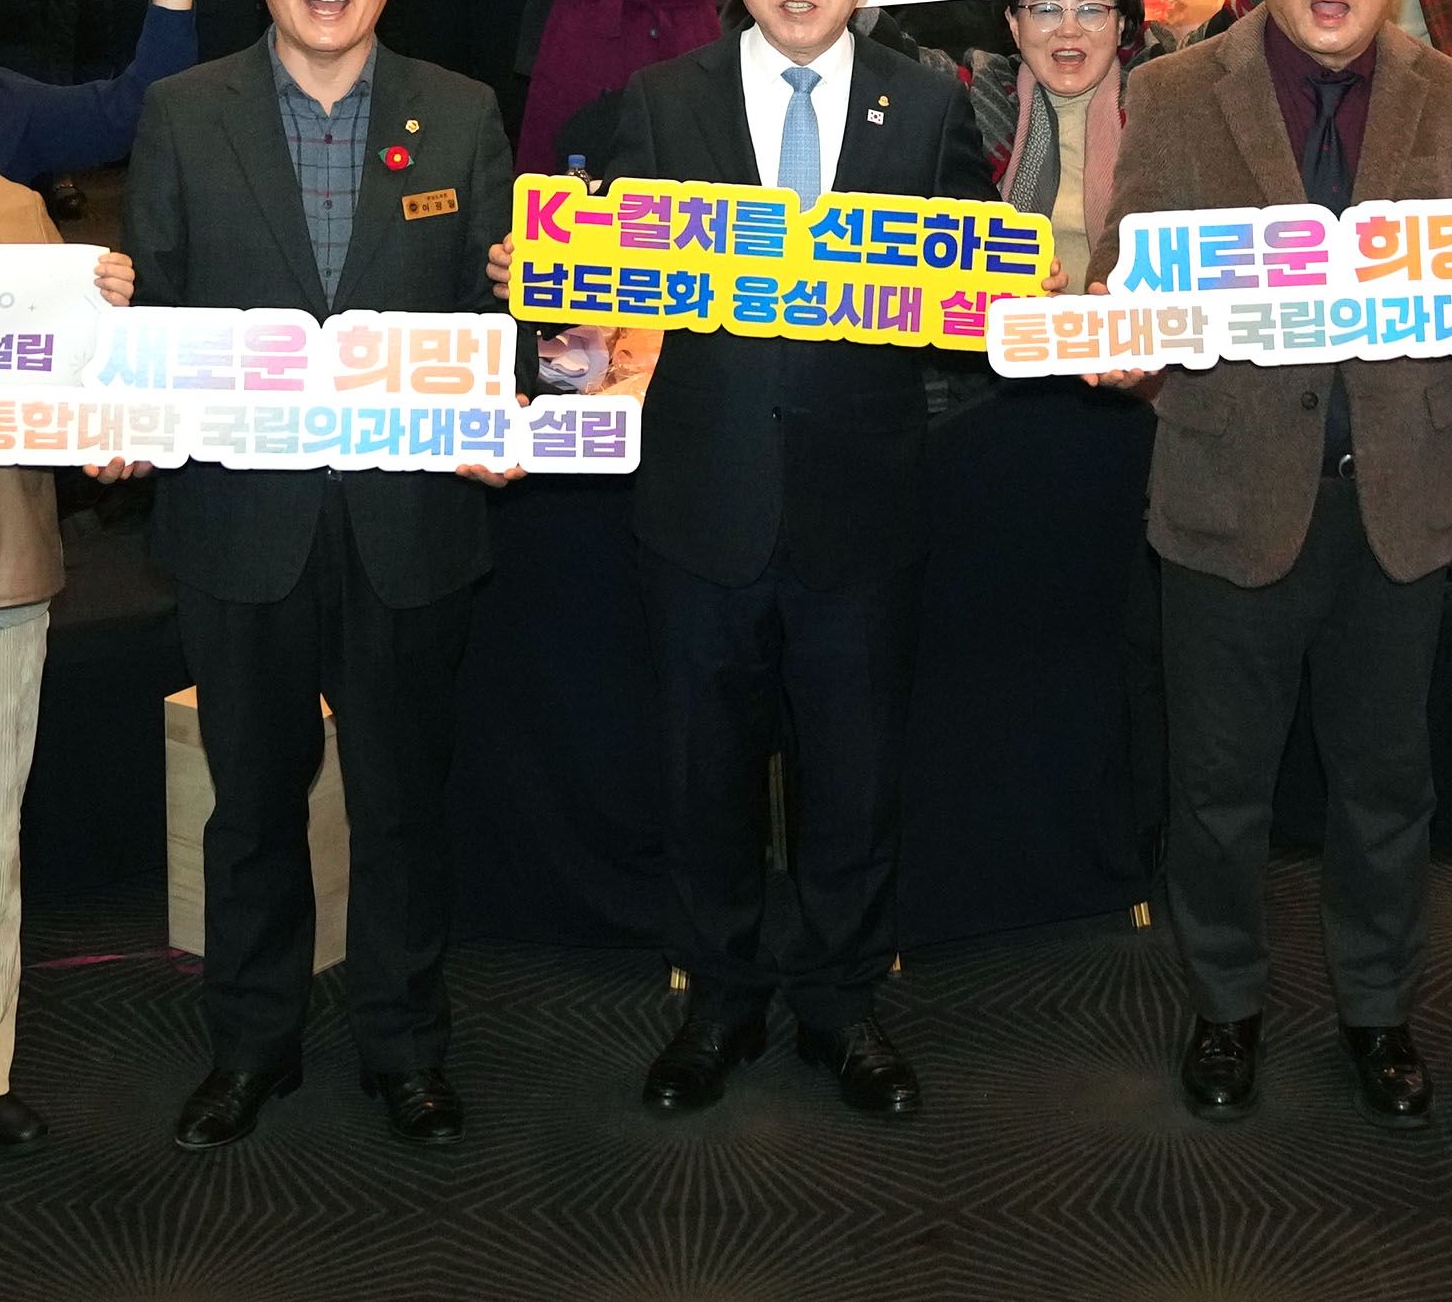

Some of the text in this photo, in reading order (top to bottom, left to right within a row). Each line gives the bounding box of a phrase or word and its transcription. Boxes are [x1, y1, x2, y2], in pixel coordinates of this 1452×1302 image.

[523, 188, 1040, 275] K-컬처를 선도하는
[1124, 218, 1329, 293] 새로운
[521, 261, 714, 318] 남도문화
[731, 275, 923, 333] 융성시대
[1000, 304, 1208, 362] 통합대학
[96, 322, 503, 396] 새로운 희망!
[199, 403, 510, 458] 국립의과대학
[528, 409, 627, 459] 설립
